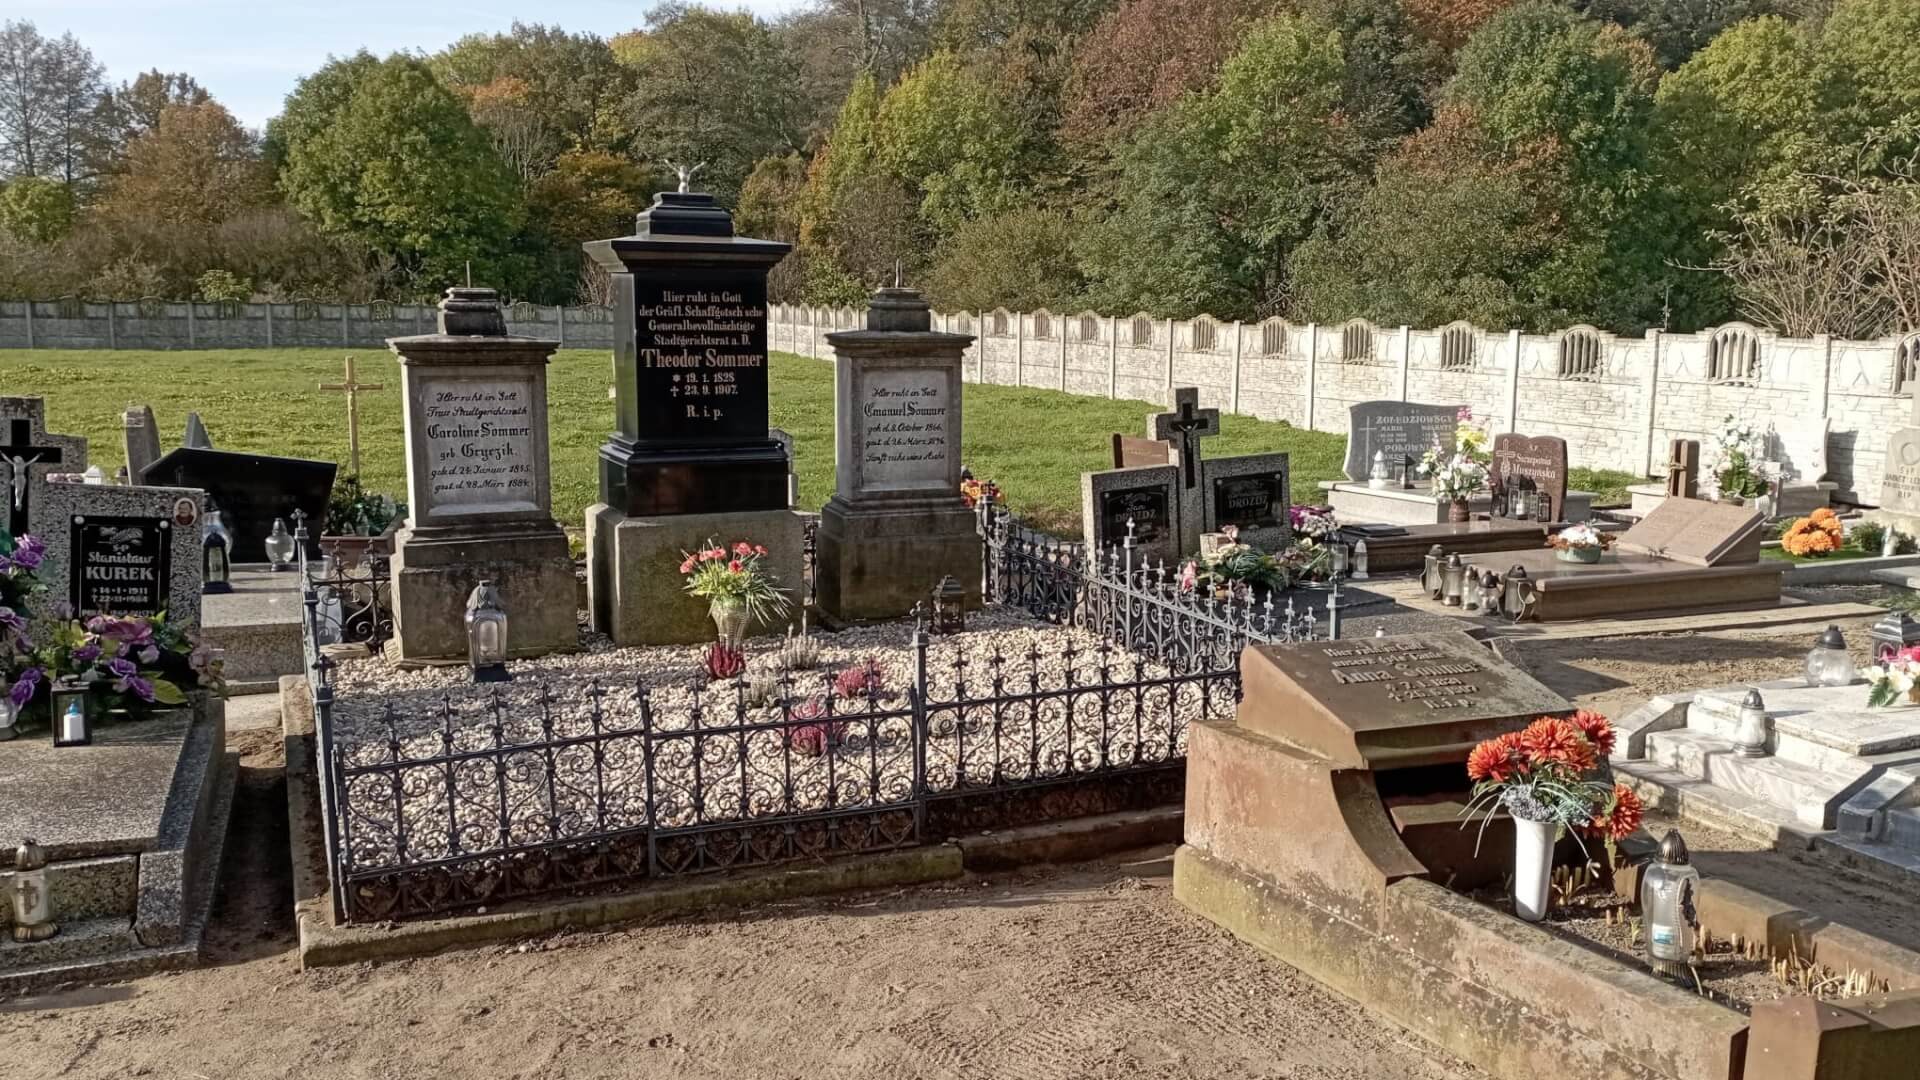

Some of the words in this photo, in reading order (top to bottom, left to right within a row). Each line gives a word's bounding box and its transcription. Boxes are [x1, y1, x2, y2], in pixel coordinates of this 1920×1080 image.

[663, 290, 685, 303] Hier
[687, 291, 707, 303] ruht
[711, 291, 720, 303] in
[722, 291, 742, 303] Gott
[640, 305, 653, 317] der
[654, 334, 729, 347] Stadtgerichtsrat
[641, 348, 702, 368] Theodor
[705, 348, 763, 367] Sommer
[460, 392, 482, 402] ruht
[485, 394, 495, 402] in
[864, 401, 906, 417] Emanuel
[906, 401, 946, 416] Sommer
[427, 423, 480, 439] Caroline
[480, 422, 530, 438] Sommer
[472, 464, 507, 476] Januar
[86, 566, 154, 580] KUREK
[1322, 648, 1353, 657] Hier
[1331, 669, 1396, 684] Anna
[1395, 661, 1479, 677] Sommer
